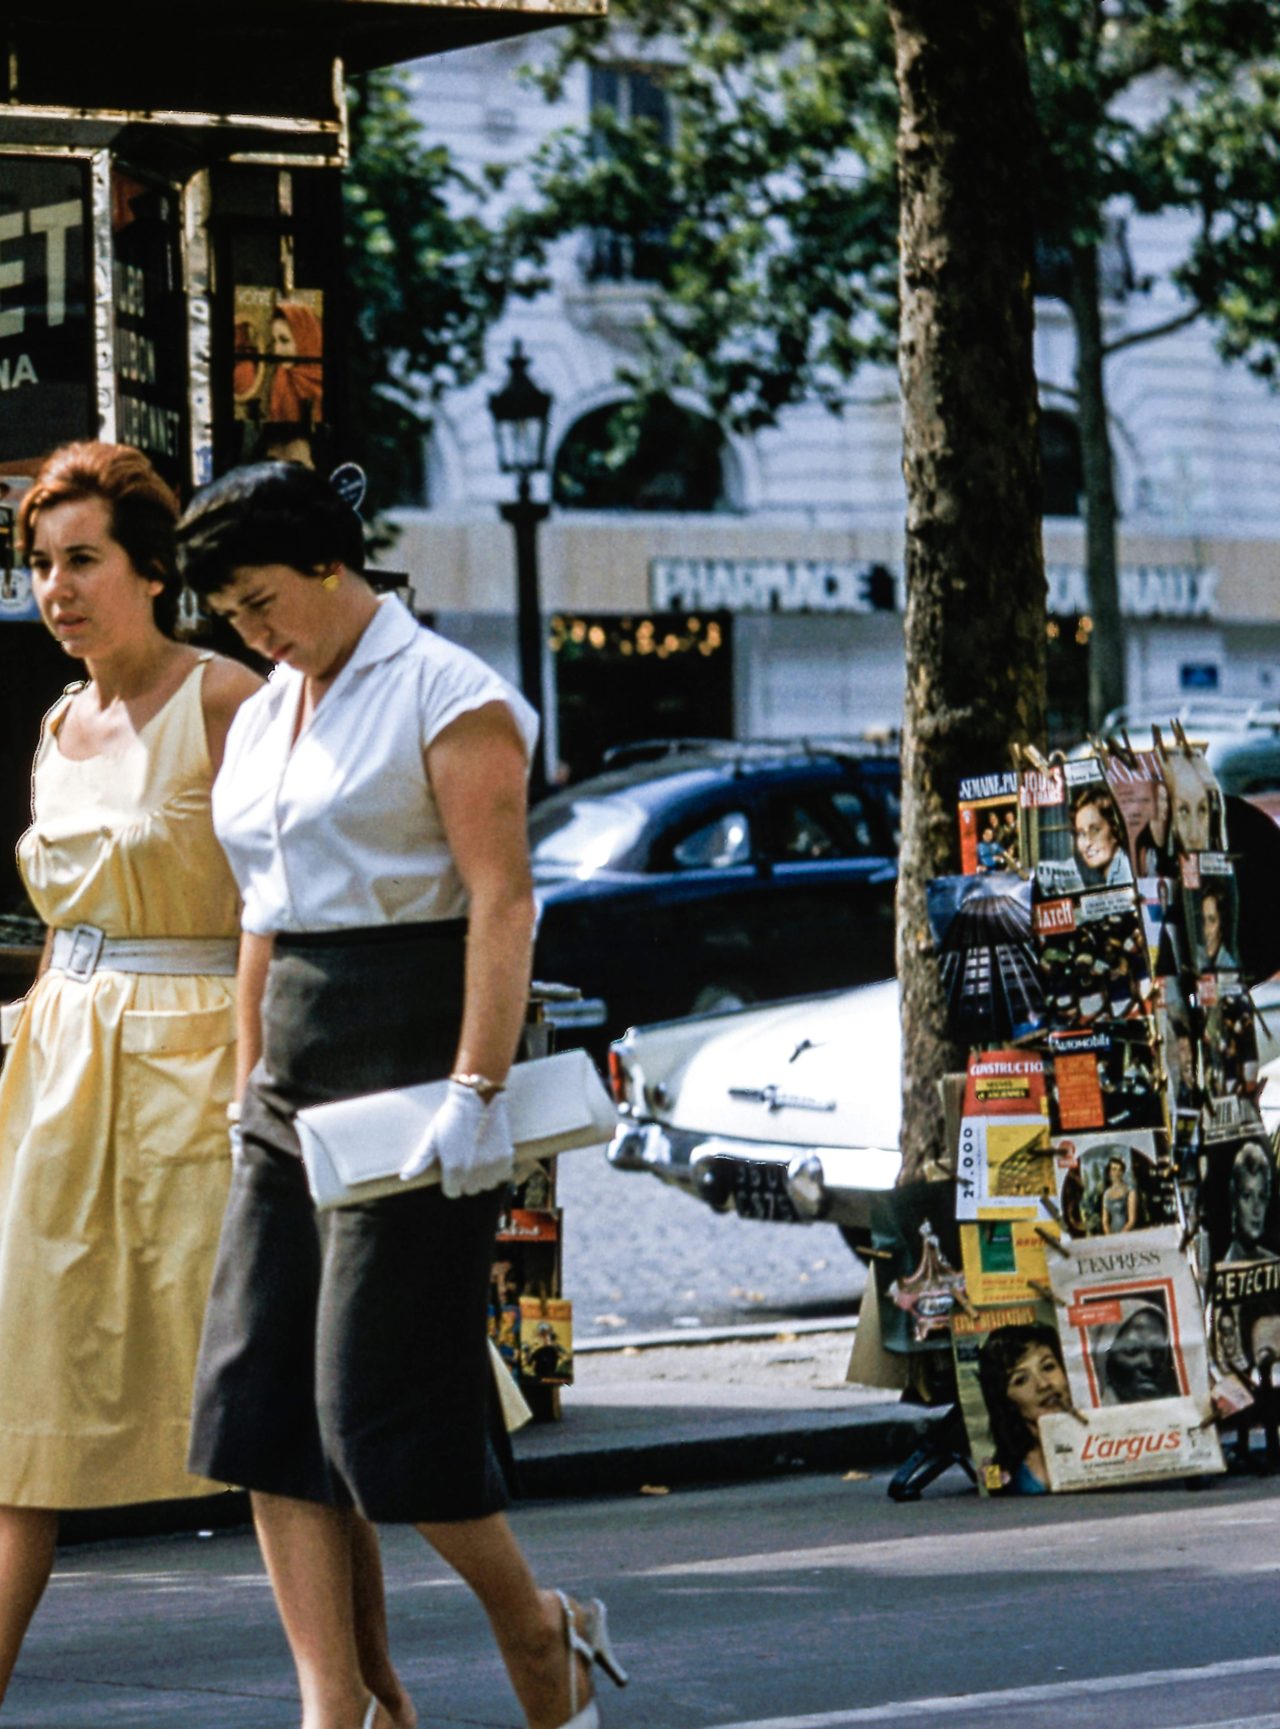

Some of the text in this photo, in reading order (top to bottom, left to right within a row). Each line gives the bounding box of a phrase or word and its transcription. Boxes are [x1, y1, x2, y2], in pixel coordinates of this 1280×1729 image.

[970, 1060, 1044, 1076] CONSTRUCTIO
[1076, 1252, 1162, 1276] L'EXPRESS
[1080, 1430, 1182, 1461] L'argus
